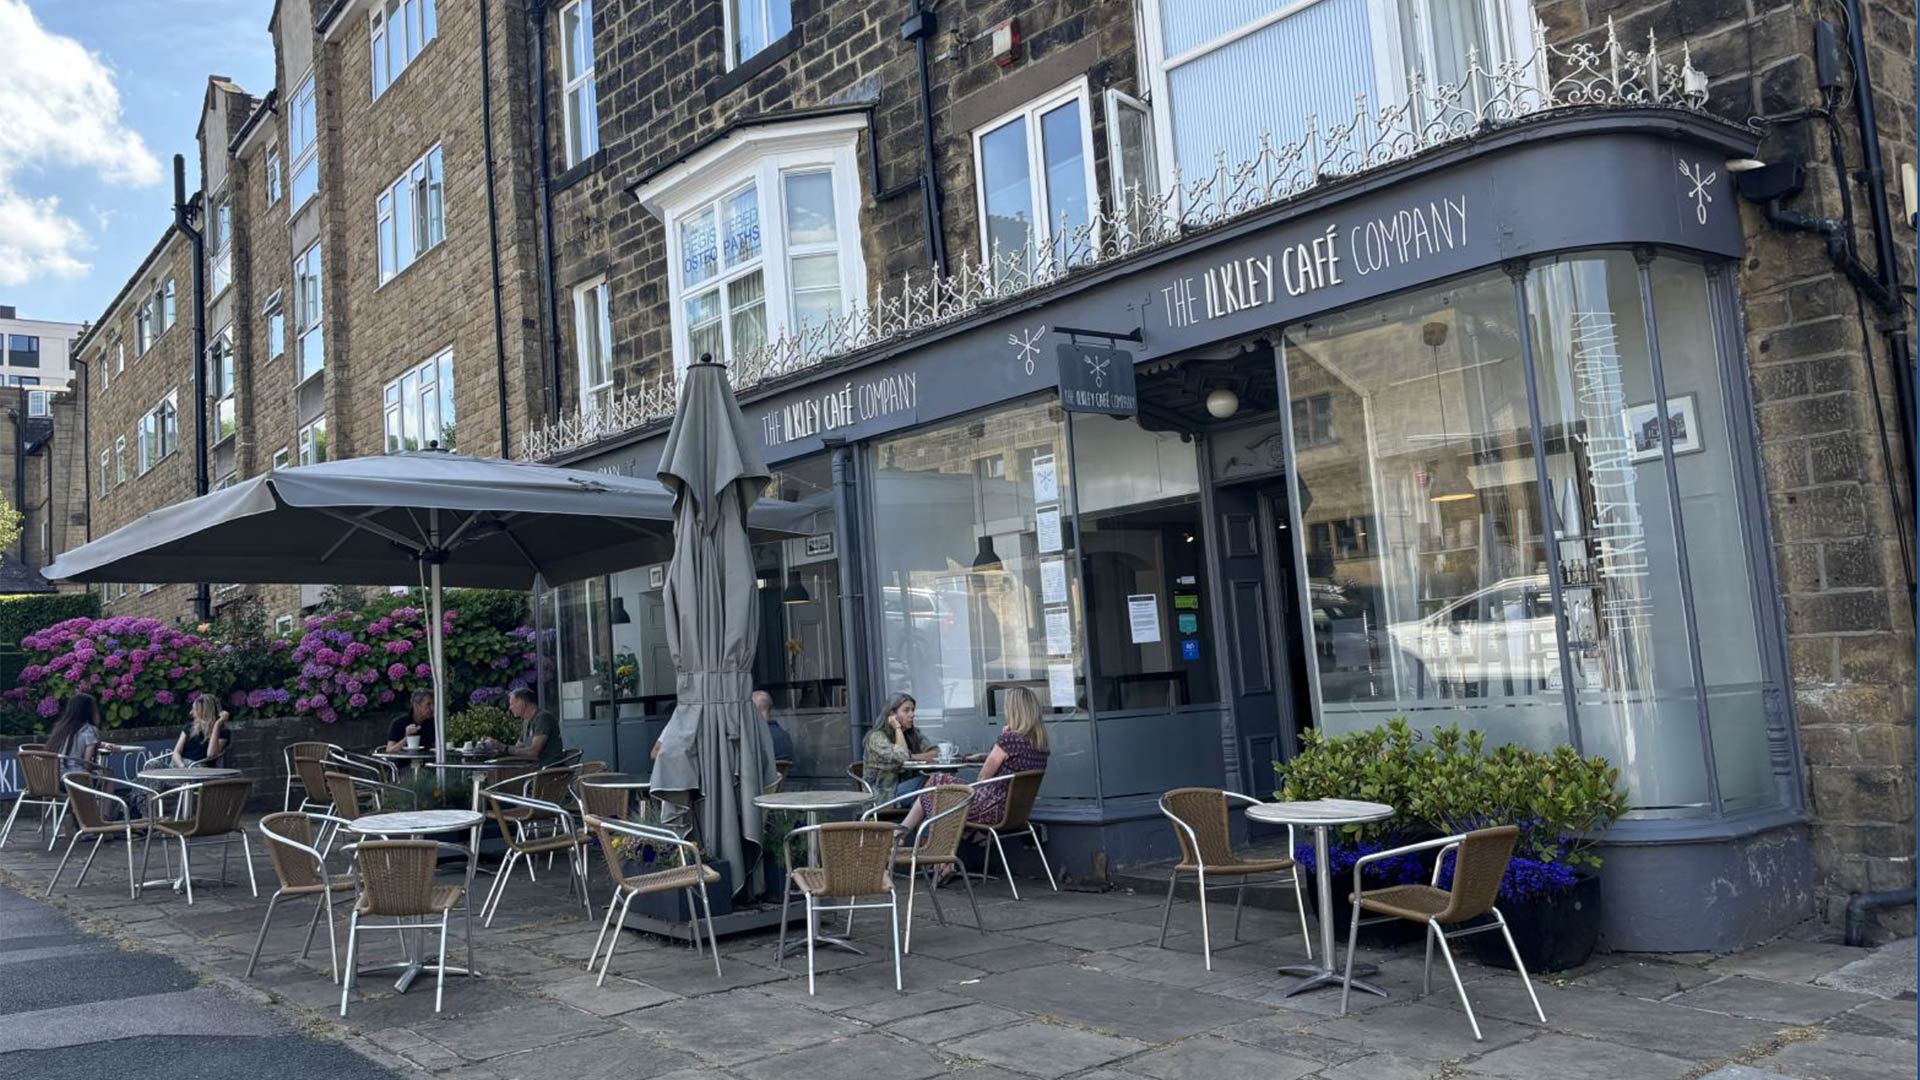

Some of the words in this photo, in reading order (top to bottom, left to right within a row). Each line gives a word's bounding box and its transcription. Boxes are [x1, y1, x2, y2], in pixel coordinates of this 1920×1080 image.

[1161, 278, 1199, 329] THE
[1203, 255, 1275, 320] ILKLEY
[1282, 224, 1343, 297] CAFÉ
[1351, 195, 1468, 276] COMPANY
[761, 410, 782, 446] THE
[783, 399, 821, 442] ILKLEY
[823, 382, 856, 430] CAFÉ
[858, 372, 917, 420] COMPANY
[1570, 307, 1627, 419] COMPANY
[1593, 502, 1651, 578] ILKLEY
